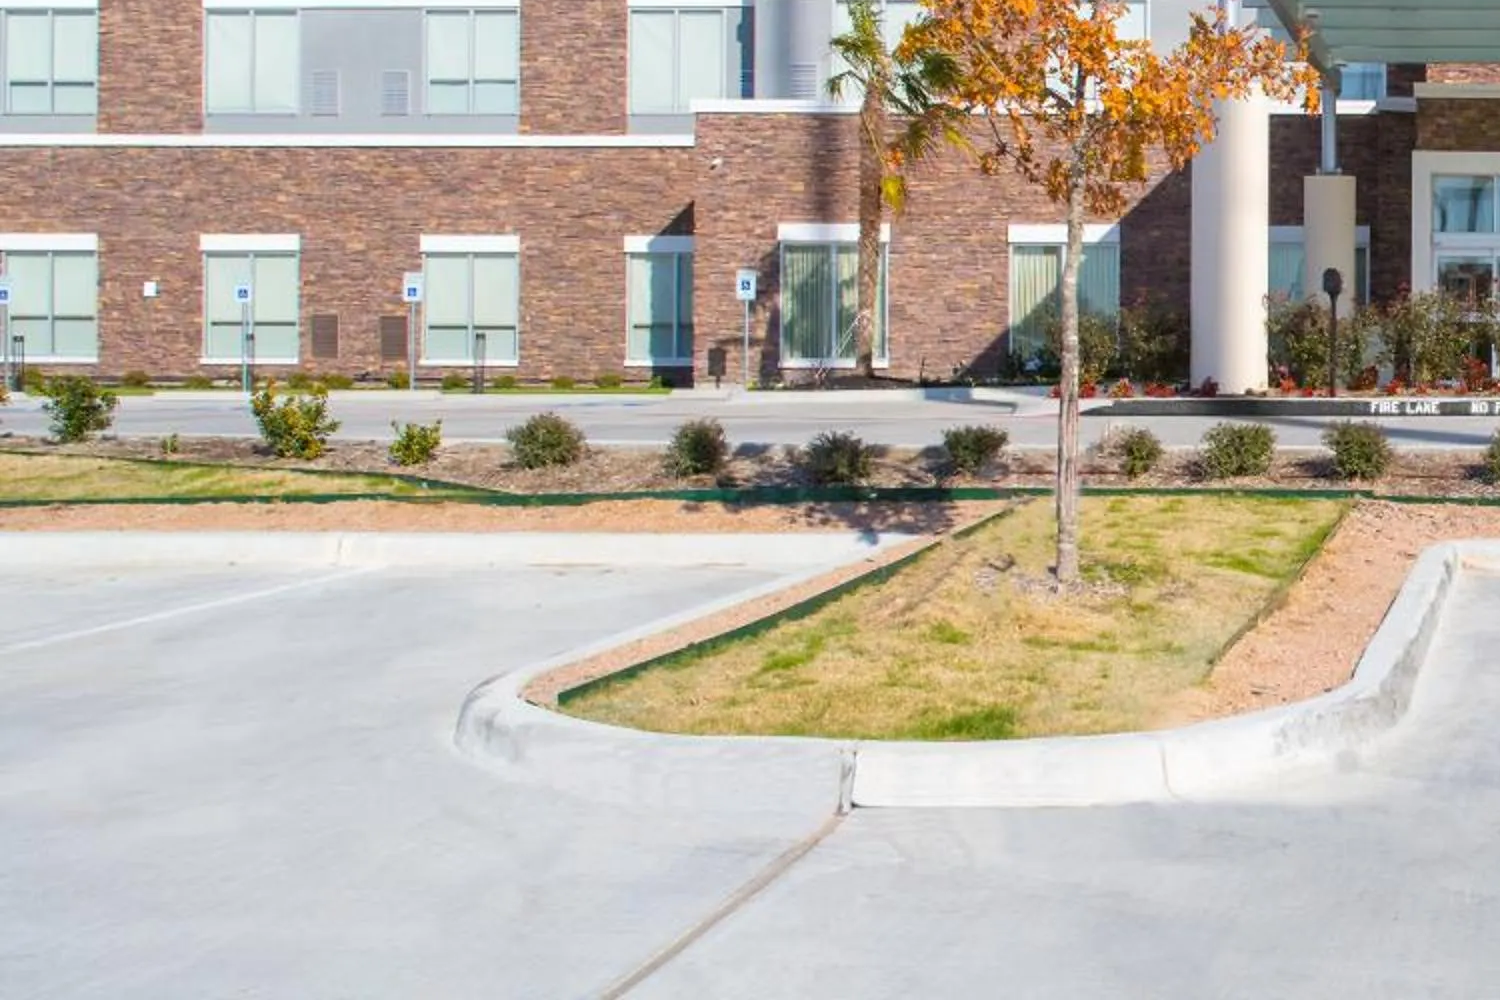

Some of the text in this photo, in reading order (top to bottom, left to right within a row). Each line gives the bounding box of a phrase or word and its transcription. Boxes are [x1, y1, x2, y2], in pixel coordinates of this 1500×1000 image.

[1370, 401, 1400, 414] FIRE
[1405, 401, 1440, 414] LANE
[1471, 401, 1489, 414] NO
